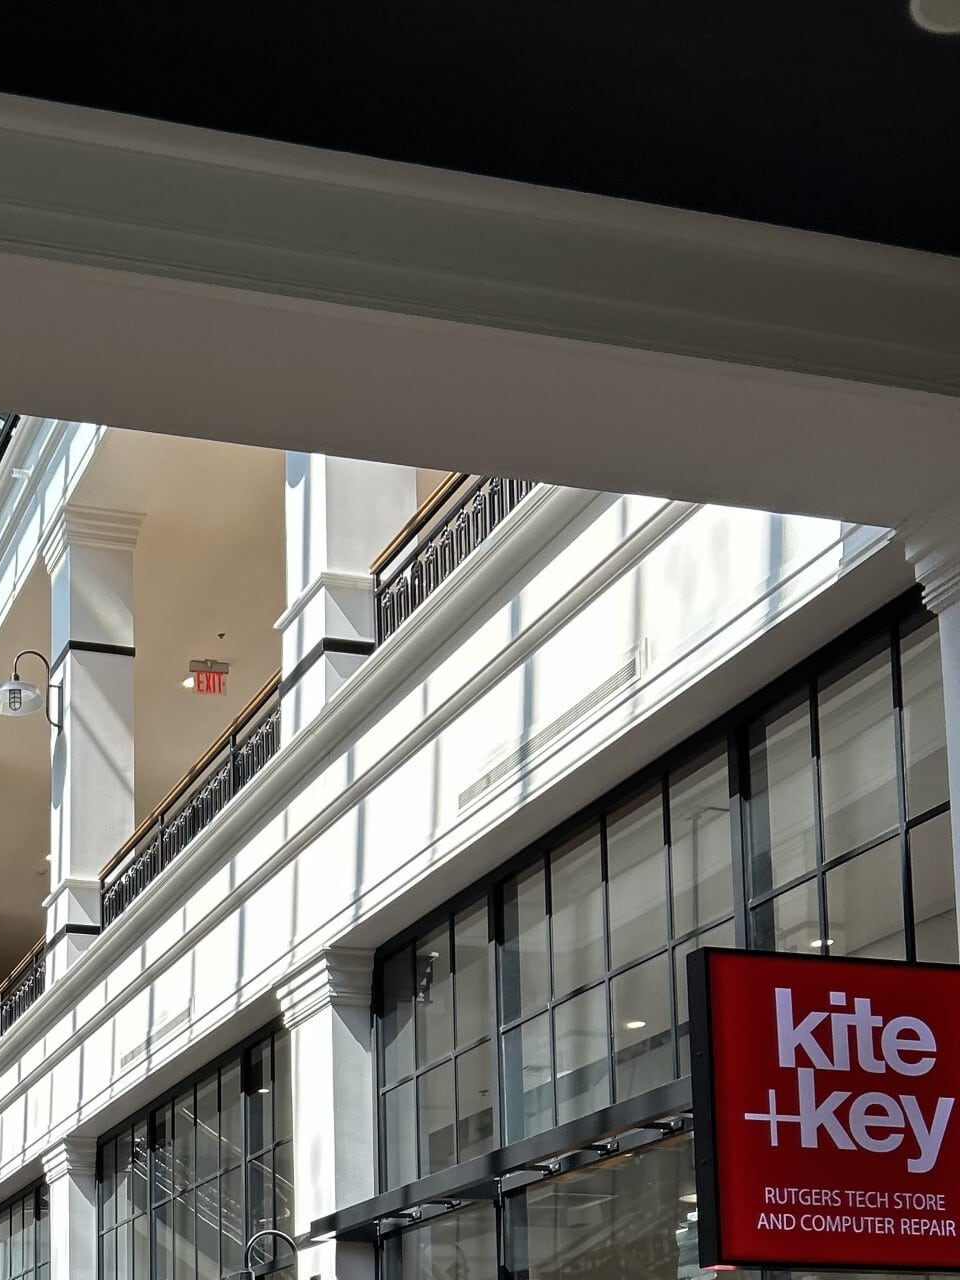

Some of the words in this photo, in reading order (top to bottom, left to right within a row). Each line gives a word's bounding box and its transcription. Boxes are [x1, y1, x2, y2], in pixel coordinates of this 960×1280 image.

[197, 671, 223, 693] EXIT
[774, 987, 937, 1077] kite
[744, 1066, 956, 1173] +key
[764, 1186, 842, 1207] RUTGERS
[844, 1190, 889, 1209] TECH
[893, 1191, 946, 1211] STORE
[757, 1213, 796, 1231] AND
[800, 1214, 895, 1235] COMPUTER
[900, 1218, 957, 1237] REPAIR
